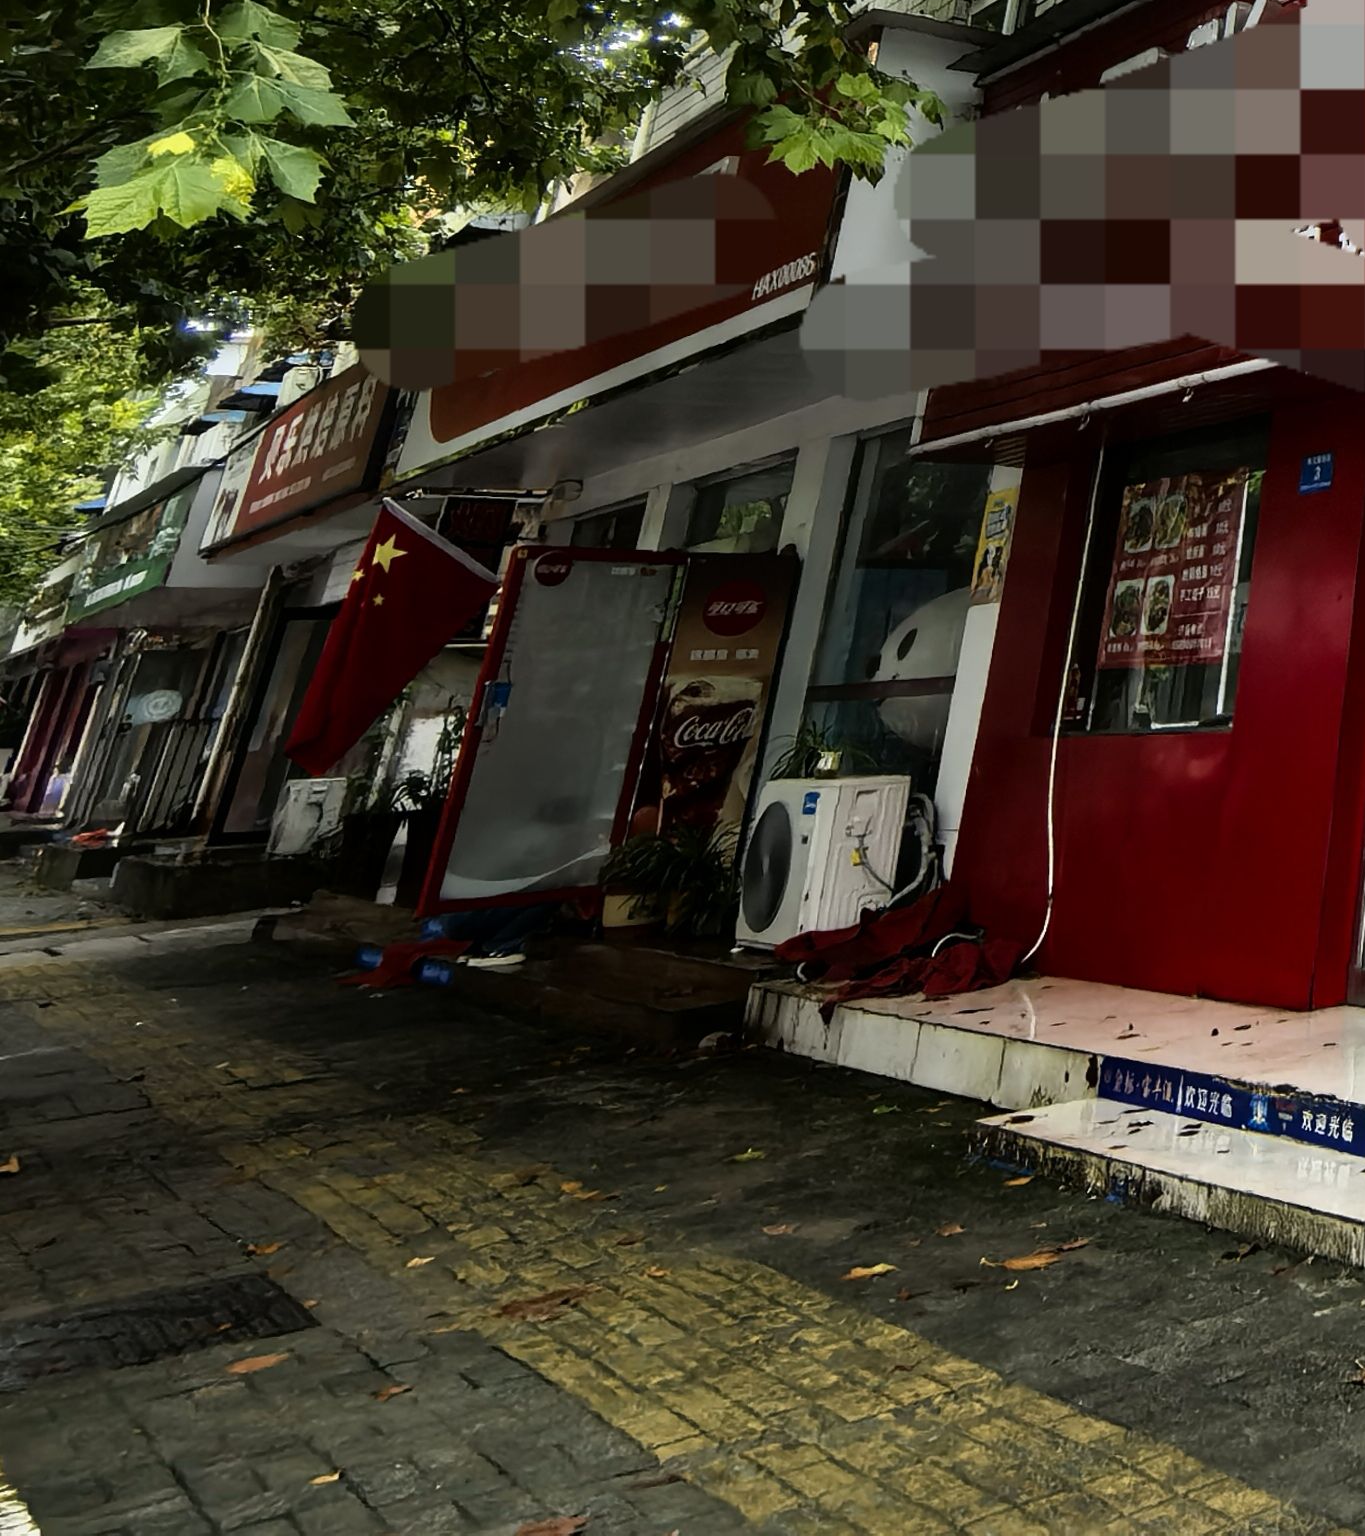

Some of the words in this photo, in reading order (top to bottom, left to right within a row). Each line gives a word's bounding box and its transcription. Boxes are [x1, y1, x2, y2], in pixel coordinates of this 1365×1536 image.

[1184, 1085, 1233, 1119] 欢迎光临
[1301, 1109, 1354, 1143] 欢迎光临
